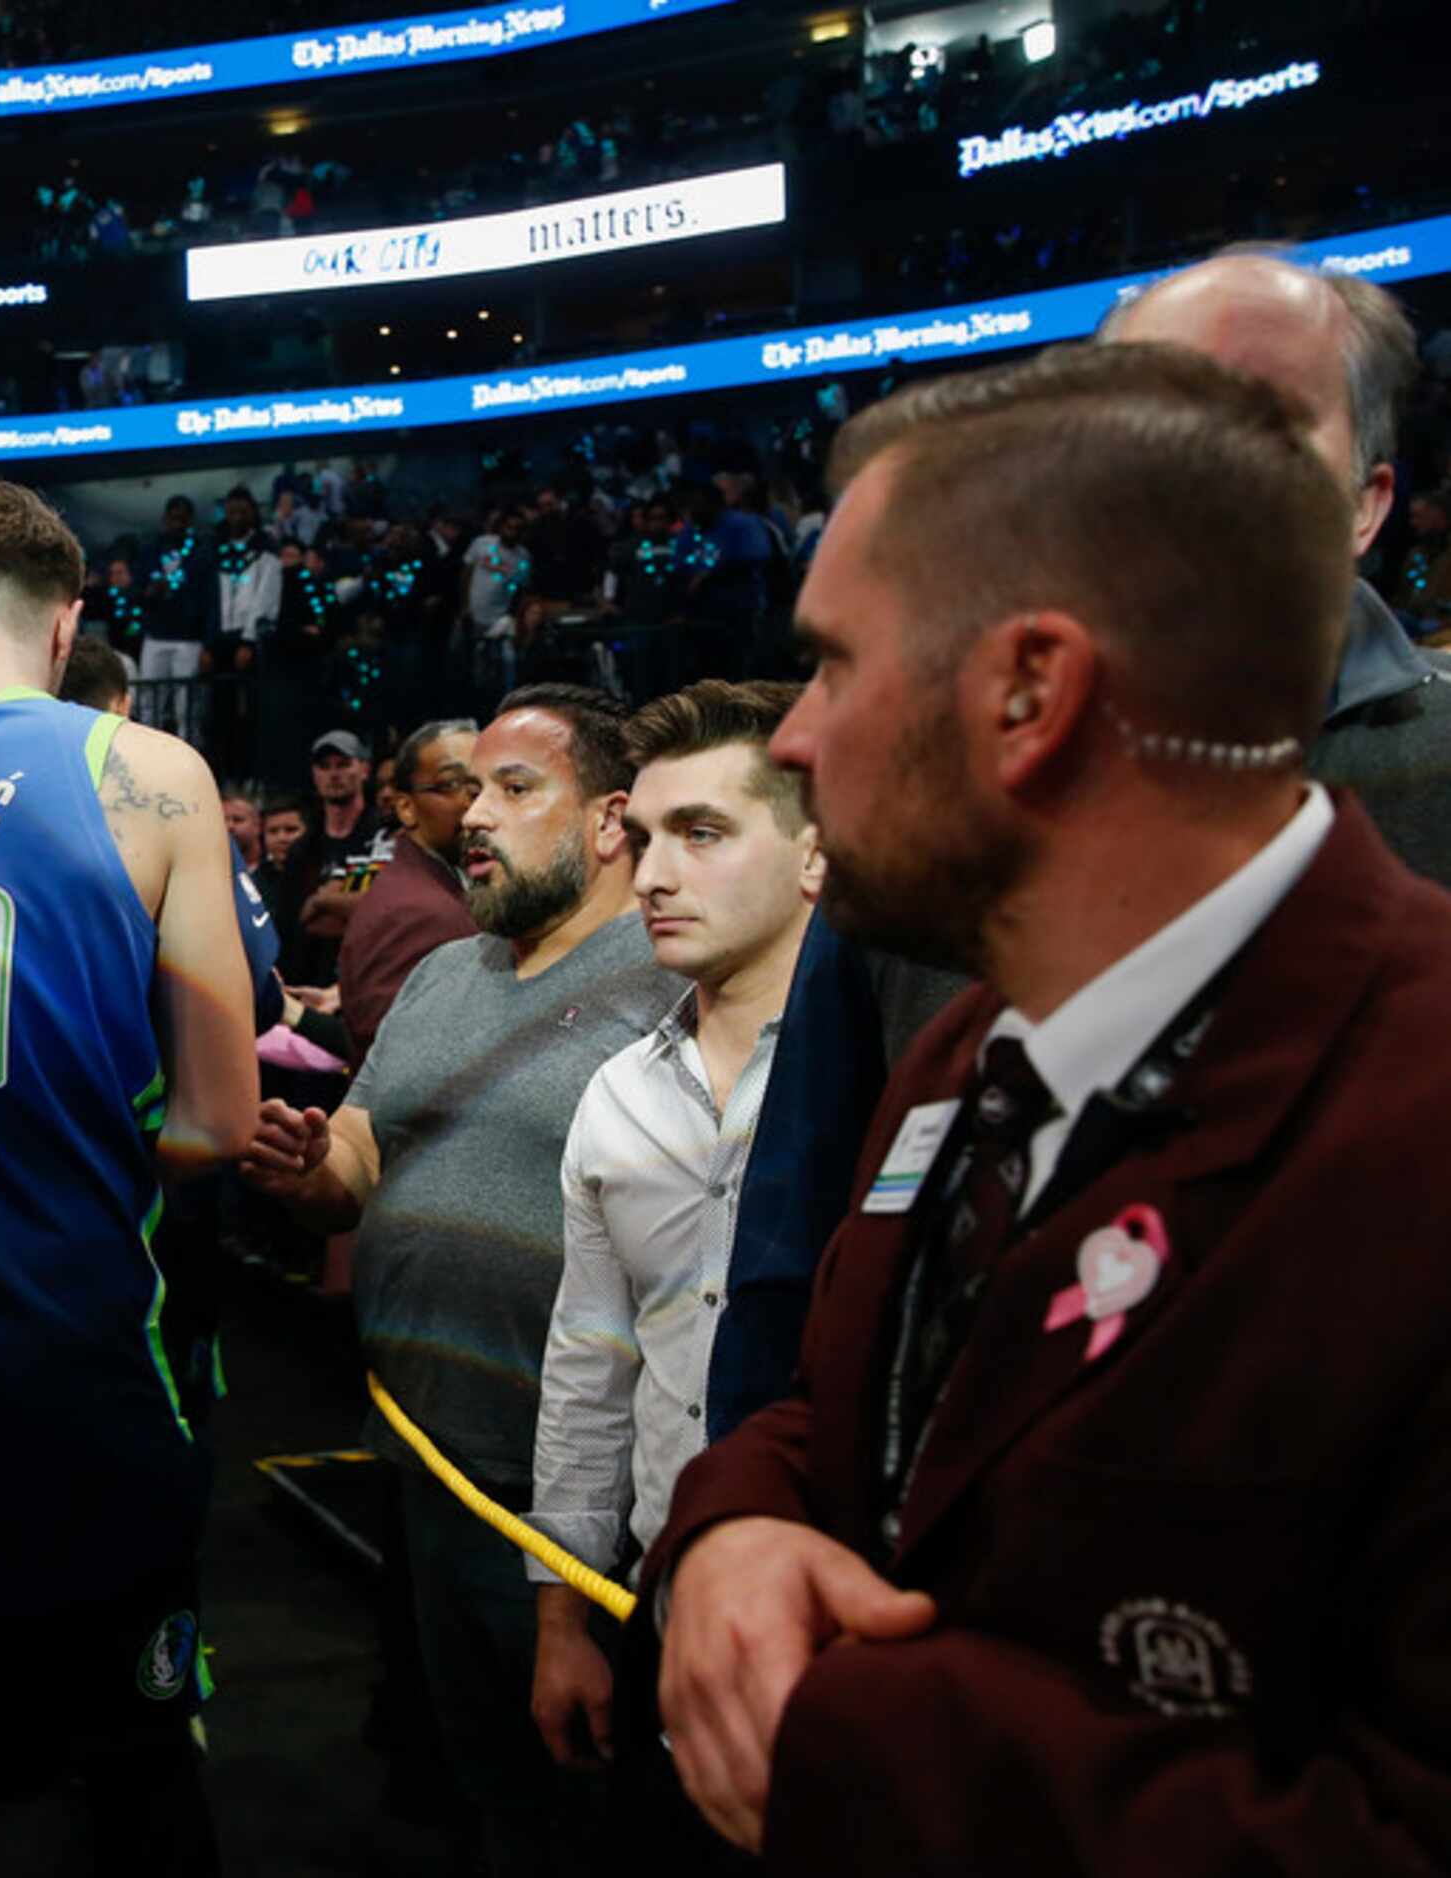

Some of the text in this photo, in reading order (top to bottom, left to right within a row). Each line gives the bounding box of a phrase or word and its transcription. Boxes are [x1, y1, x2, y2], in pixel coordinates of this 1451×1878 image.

[292, 5, 565, 68] The Dallas Morning News
[528, 198, 699, 253] matters.
[762, 311, 1030, 368] The Dallas Morning News
[177, 396, 403, 435] The Dallas Morning News
